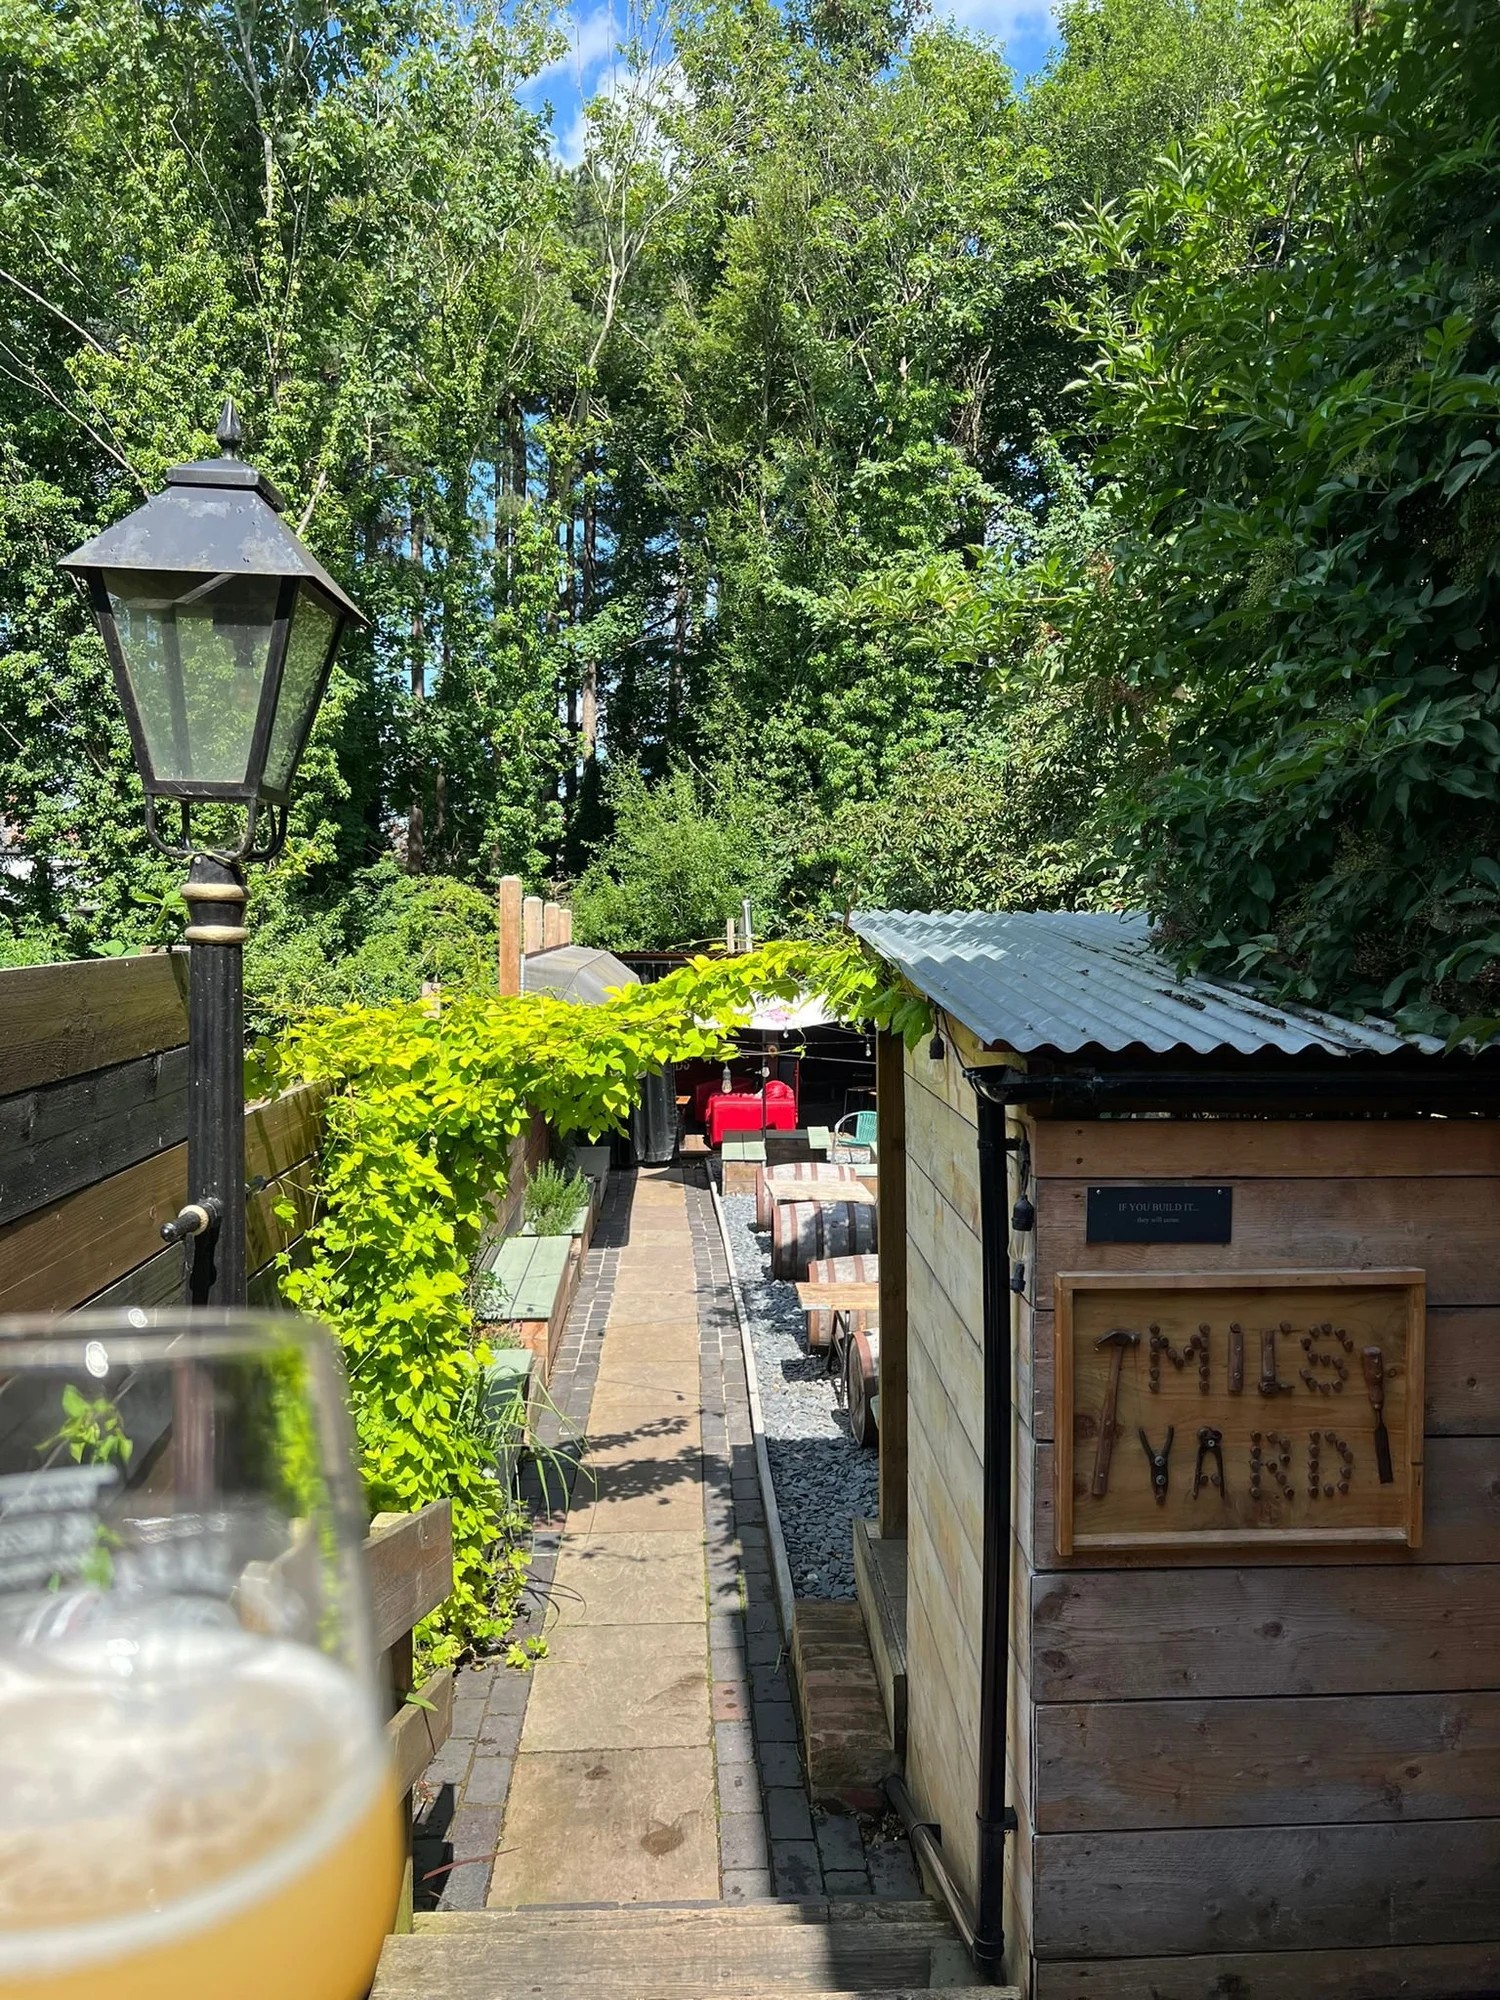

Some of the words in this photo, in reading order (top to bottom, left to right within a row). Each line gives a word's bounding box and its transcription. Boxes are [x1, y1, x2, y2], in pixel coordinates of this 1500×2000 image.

[1118, 1202, 1128, 1212] IF
[1129, 1202, 1151, 1212] YOU
[1152, 1202, 1182, 1212] BUILD
[1137, 1424, 1354, 1506] YARD
